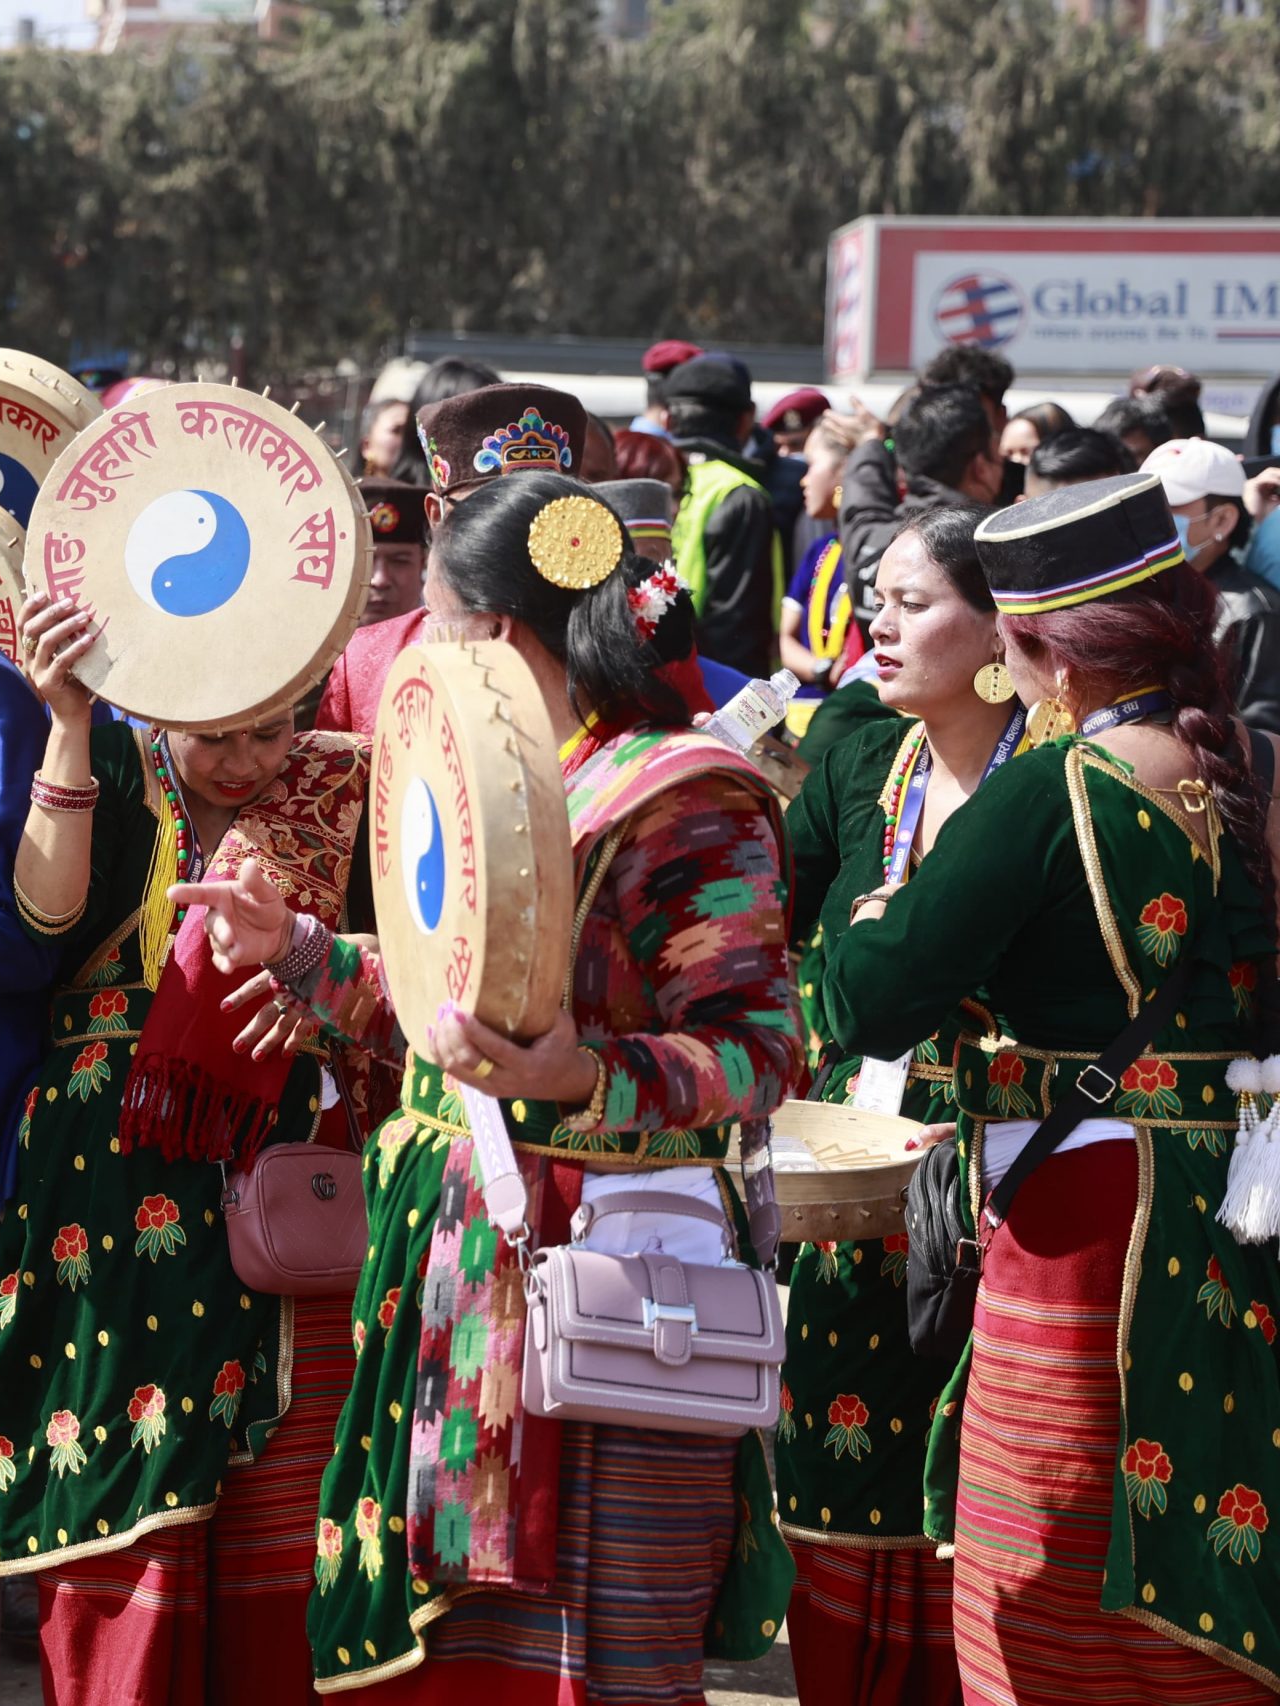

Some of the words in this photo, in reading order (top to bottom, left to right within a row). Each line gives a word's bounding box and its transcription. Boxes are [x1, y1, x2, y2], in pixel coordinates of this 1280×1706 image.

[1032, 280, 1188, 321] Global
[56, 411, 158, 511] जुहारी
[175, 401, 323, 506] कलाकार
[288, 507, 347, 590] संघ
[441, 712, 477, 916] कलाकार
